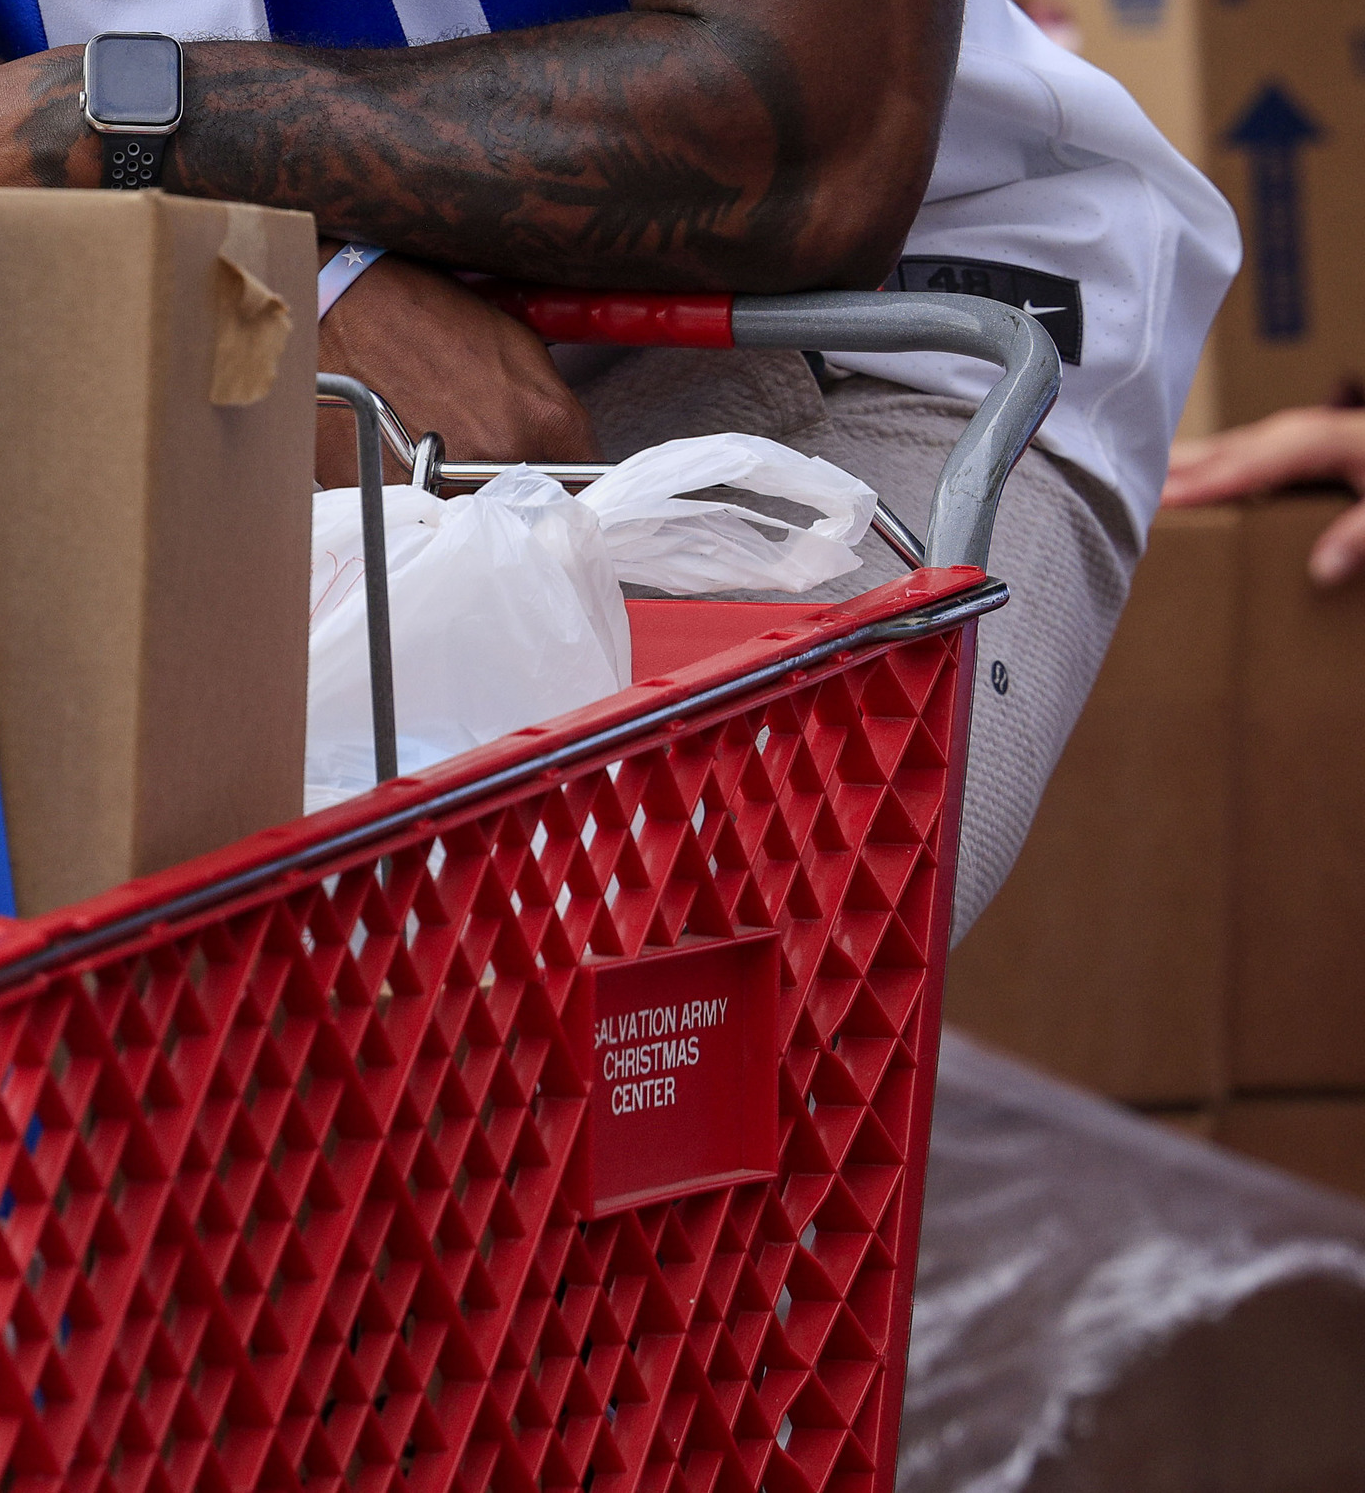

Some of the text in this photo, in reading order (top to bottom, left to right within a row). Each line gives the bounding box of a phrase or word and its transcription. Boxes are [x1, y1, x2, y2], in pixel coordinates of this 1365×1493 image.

[680, 997, 728, 1031] ARMY
[603, 1036, 700, 1081] CHRISTMAS
[611, 1077, 675, 1116] CENTER
